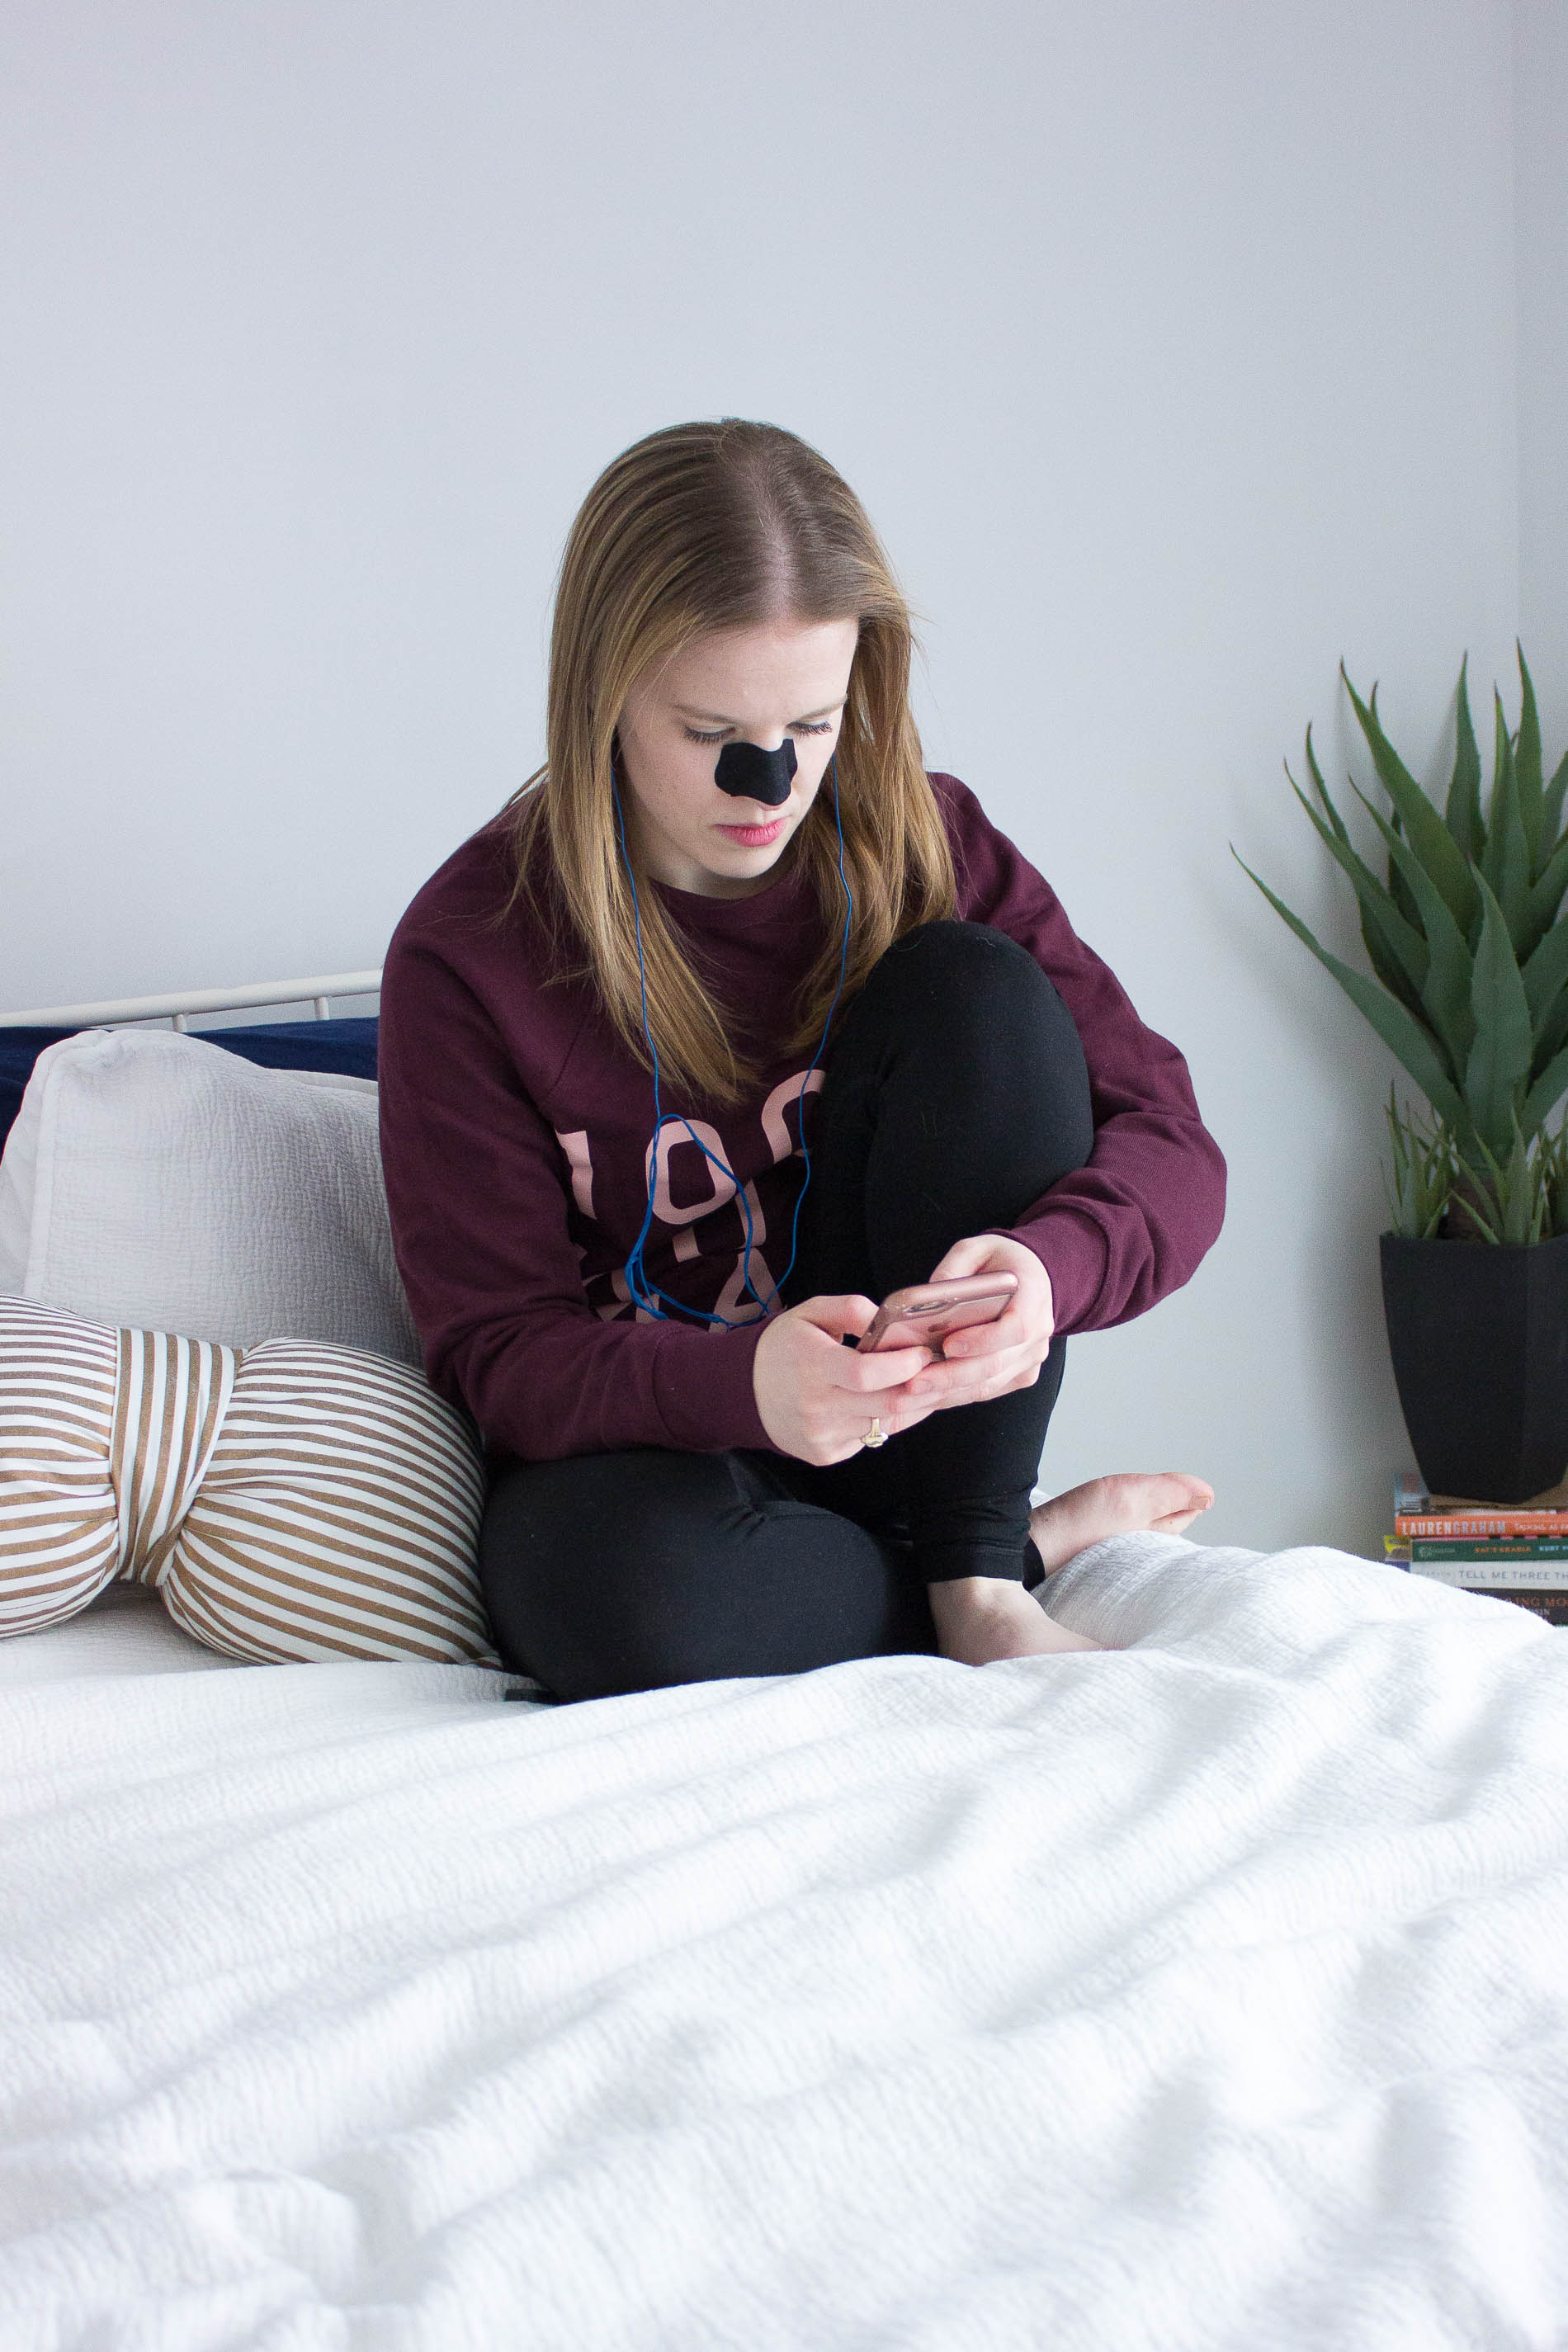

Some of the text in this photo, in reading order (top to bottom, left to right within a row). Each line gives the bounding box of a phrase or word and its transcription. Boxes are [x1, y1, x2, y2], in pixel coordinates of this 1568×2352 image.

[1459, 1570, 1486, 1580] TELL
[1491, 1570, 1508, 1580] ME
[1512, 1570, 1551, 1580] THREE
